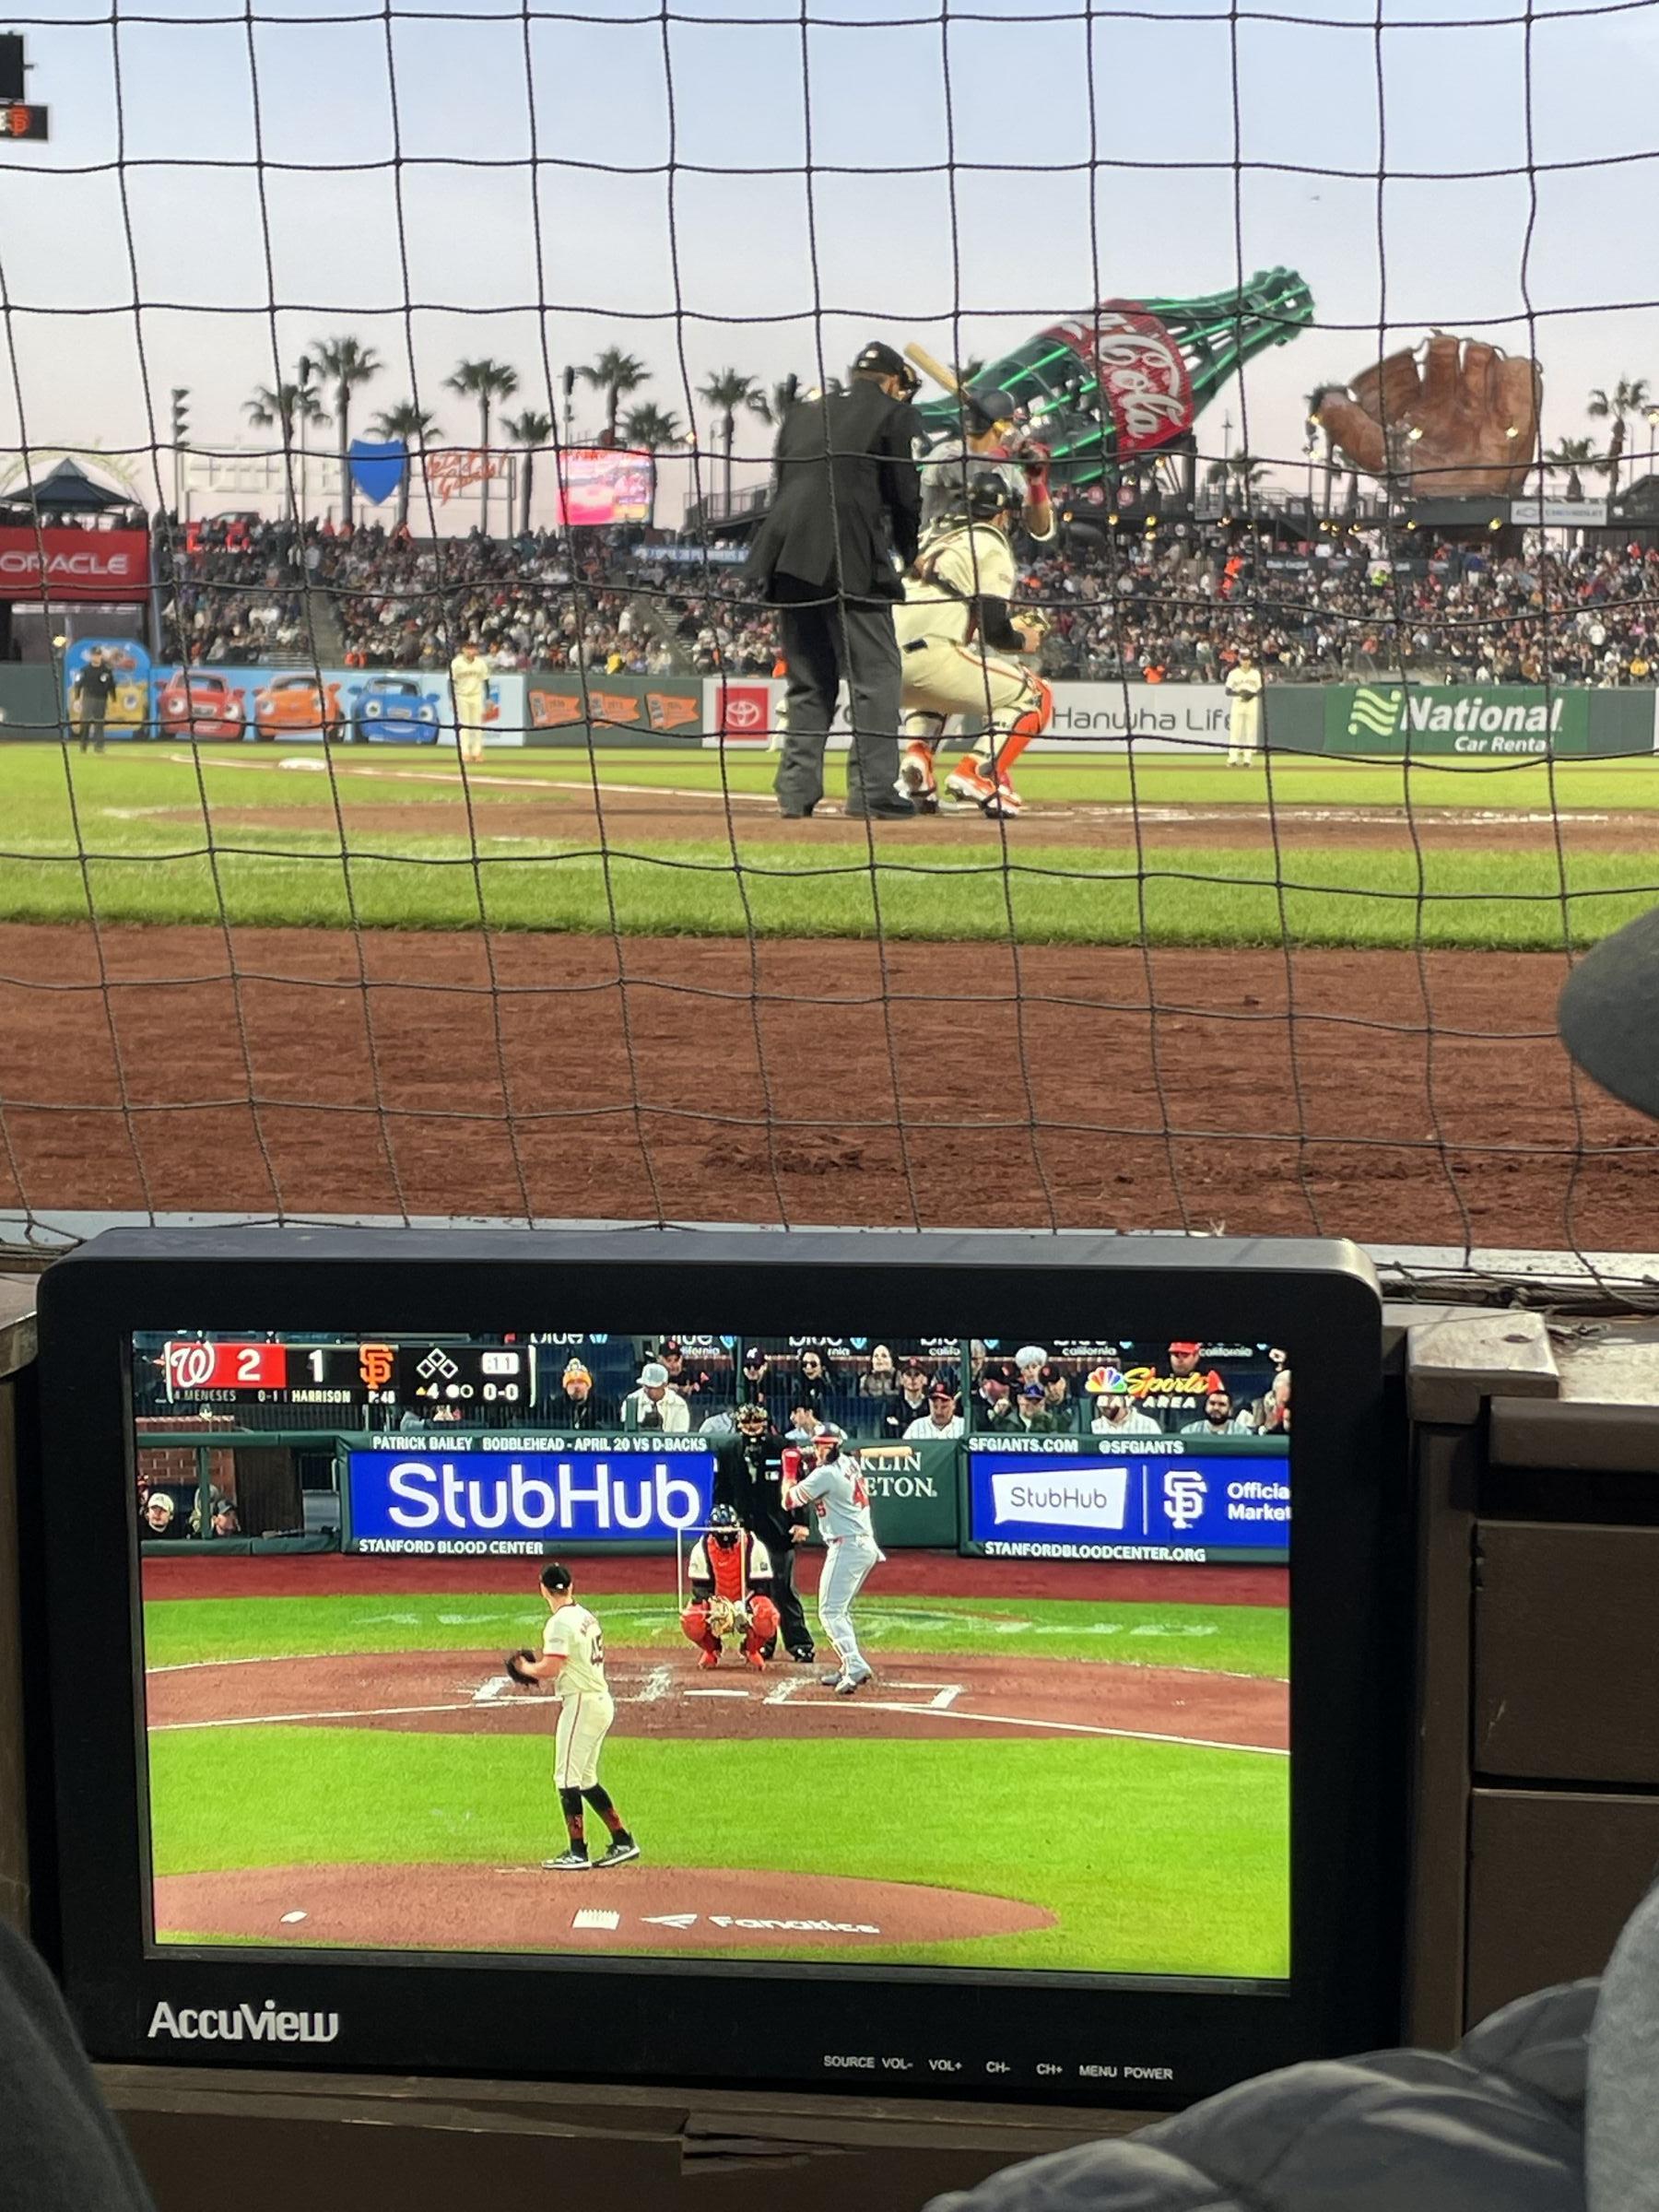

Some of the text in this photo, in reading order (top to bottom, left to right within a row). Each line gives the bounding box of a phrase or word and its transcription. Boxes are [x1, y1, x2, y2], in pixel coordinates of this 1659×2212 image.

[0, 553, 128, 575] ORACLE
[1052, 706, 1176, 731] Hanwha
[1400, 696, 1563, 732] National
[1454, 736, 1488, 752] Car
[236, 1348, 261, 1382] 2
[308, 1349, 324, 1382] 1
[426, 1382, 440, 1399] 4
[483, 1382, 519, 1401] 0-0
[1124, 1367, 1209, 1398] Sports
[291, 1390, 350, 1403] HARRISON
[1097, 1395, 1196, 1408] BAY AREA
[373, 1436, 427, 1451] PATRICK
[429, 1436, 473, 1452] BAILEY
[482, 1437, 564, 1452] BOBBLEHEAD
[574, 1437, 611, 1452] APRIL
[613, 1438, 630, 1452] 20
[632, 1438, 650, 1452] VS
[652, 1438, 707, 1453] D-BACKS
[968, 1439, 1184, 1454] SFGIANTS.COM @SFGIANTS
[388, 1463, 701, 1529] StubHub
[1011, 1486, 1108, 1509] StubHub
[359, 1538, 544, 1556] STANFORD BLOOD CENTER
[984, 1541, 1206, 1563] STANFORDBLOODCENTER.ORG
[708, 1915, 880, 1934] Fanatics
[147, 1999, 339, 2042] AccuView
[823, 2054, 1173, 2080] SOURCE VOL- VOL+ CH- CH+ MENU POWER
